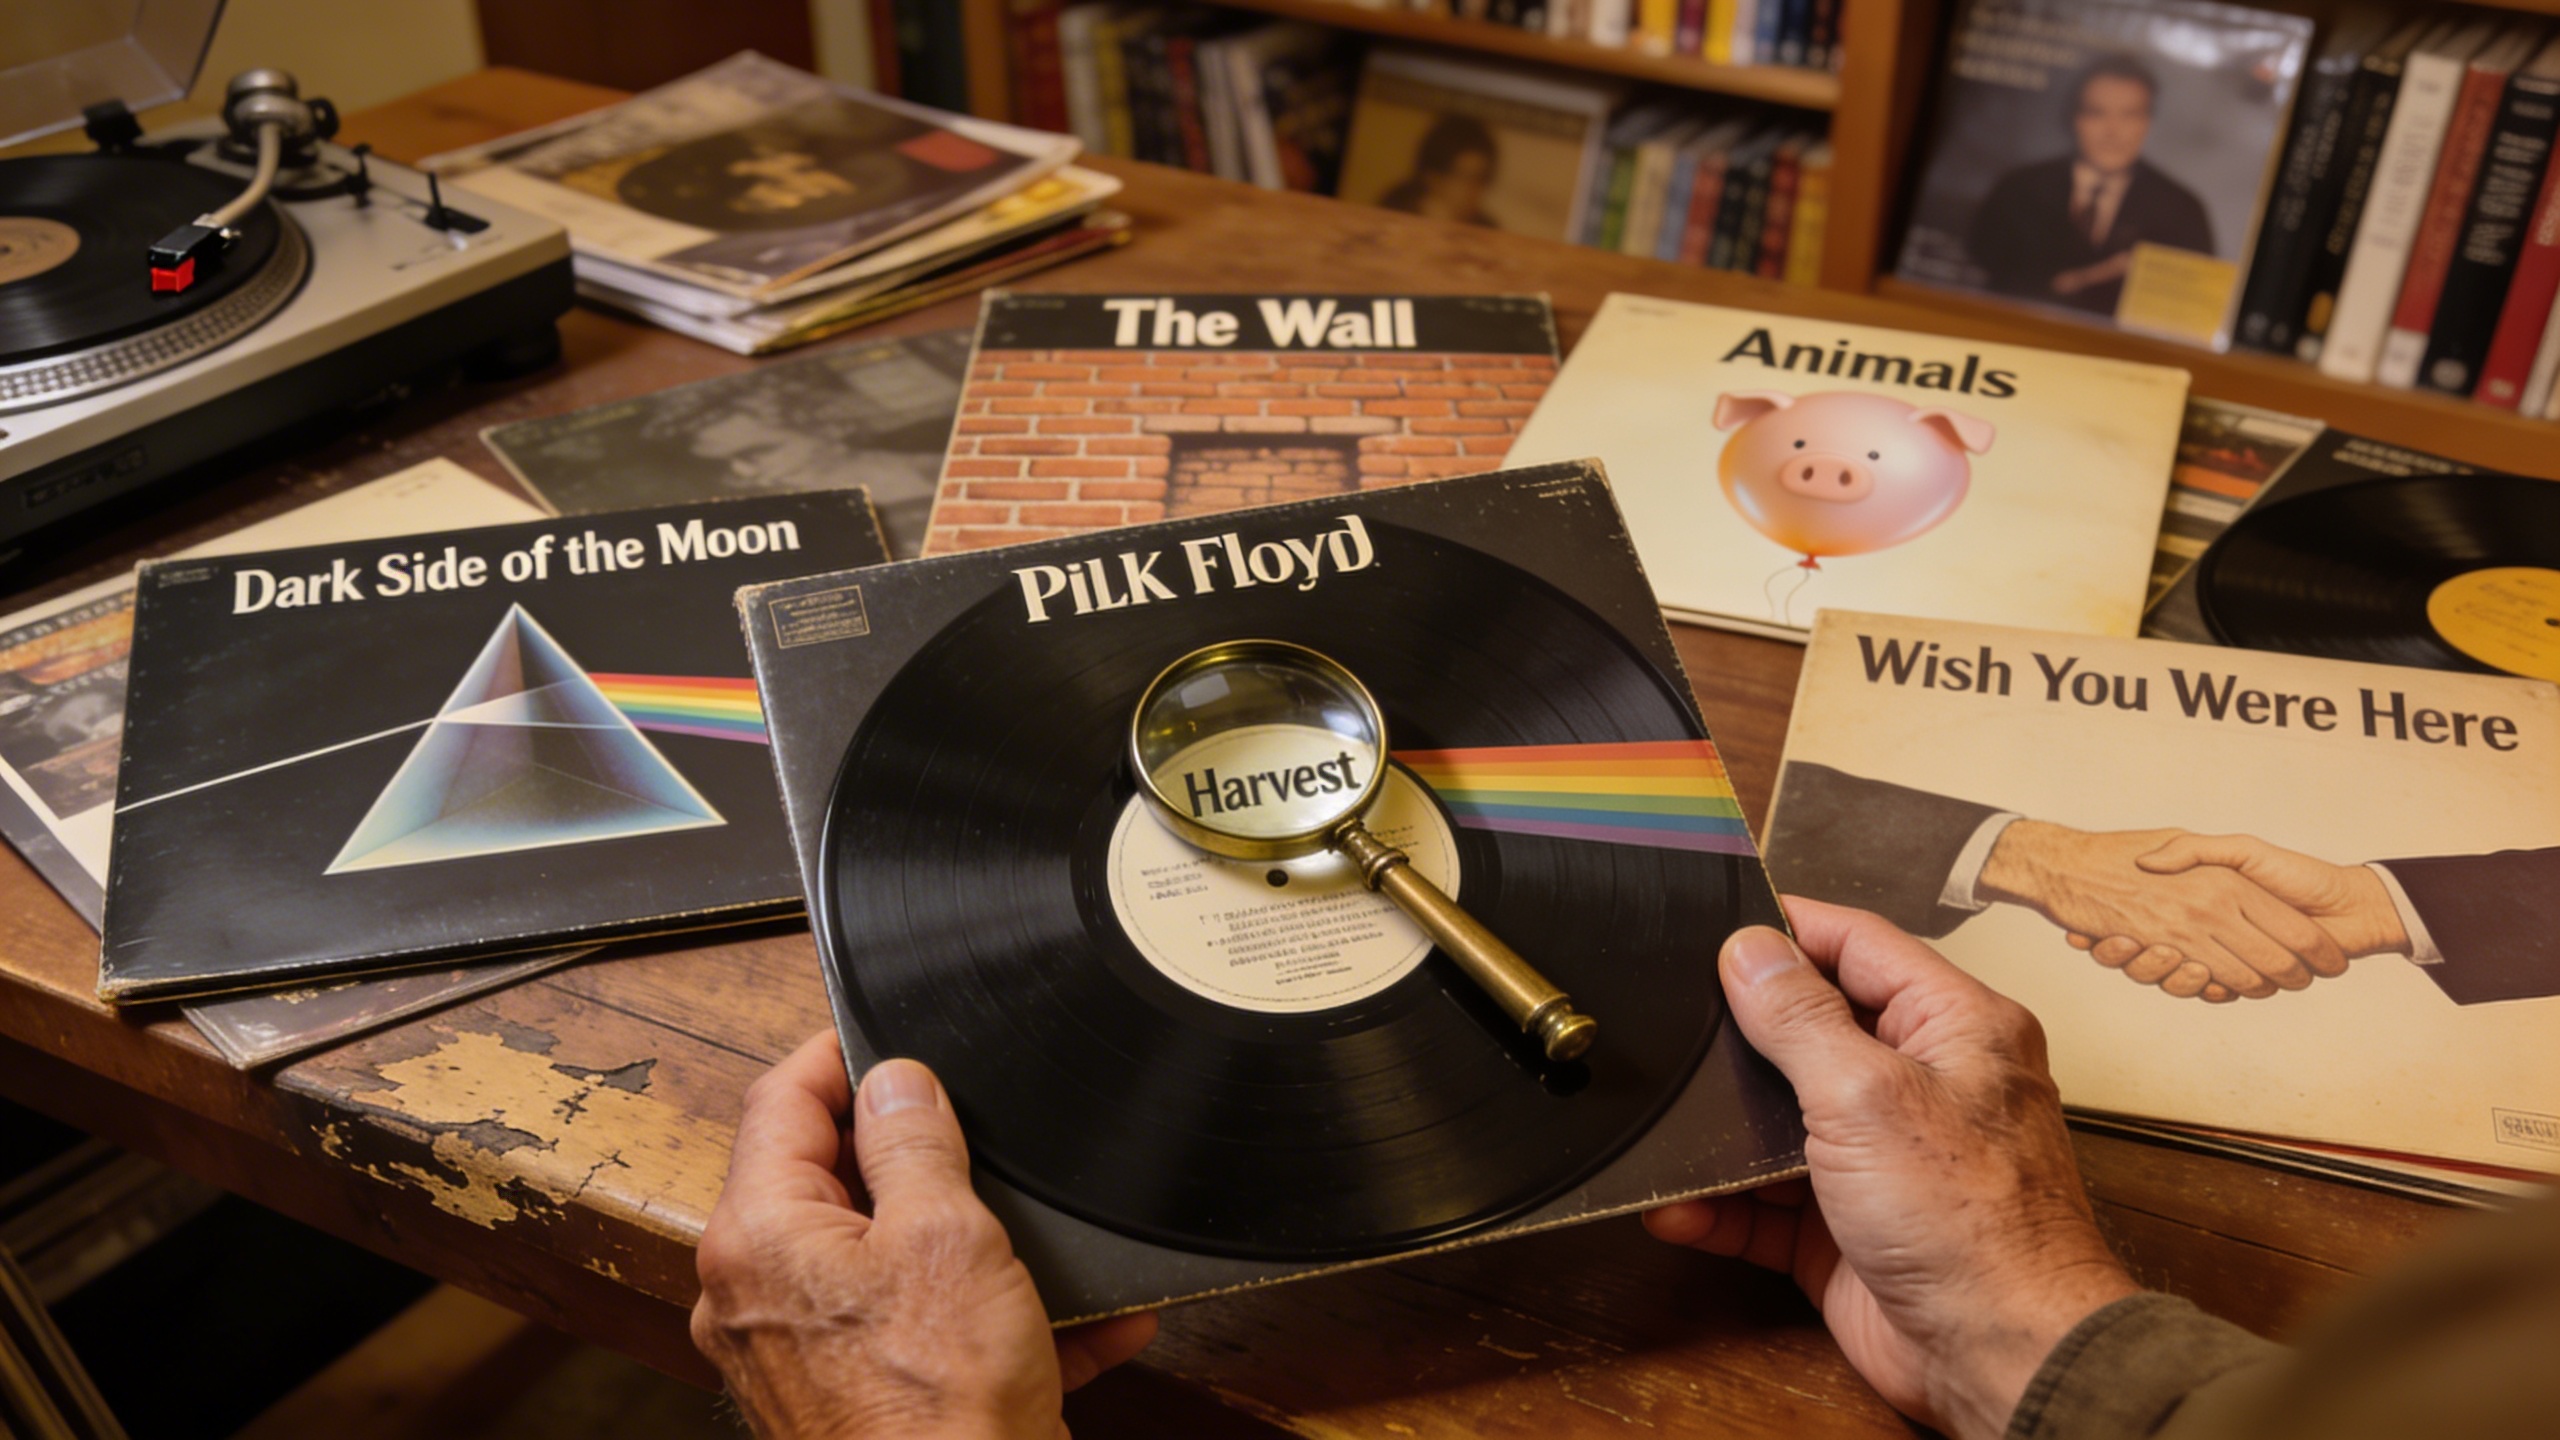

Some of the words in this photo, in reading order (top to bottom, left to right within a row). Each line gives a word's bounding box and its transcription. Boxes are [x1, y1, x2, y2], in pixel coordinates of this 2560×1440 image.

[1103, 298, 1239, 347] The
[1256, 299, 1416, 348] Wall
[1720, 327, 2018, 400] Animals
[231, 558, 366, 615] Dark
[375, 546, 488, 597] Side
[500, 534, 556, 582] of
[563, 530, 645, 575] the
[656, 519, 801, 565] Moon
[1180, 513, 1375, 592] Floyd
[1856, 634, 2013, 696] Wish
[2031, 652, 2149, 712] You
[2167, 668, 2339, 732] Were
[2358, 688, 2520, 752] Here
[1183, 750, 1361, 818] Harvest
